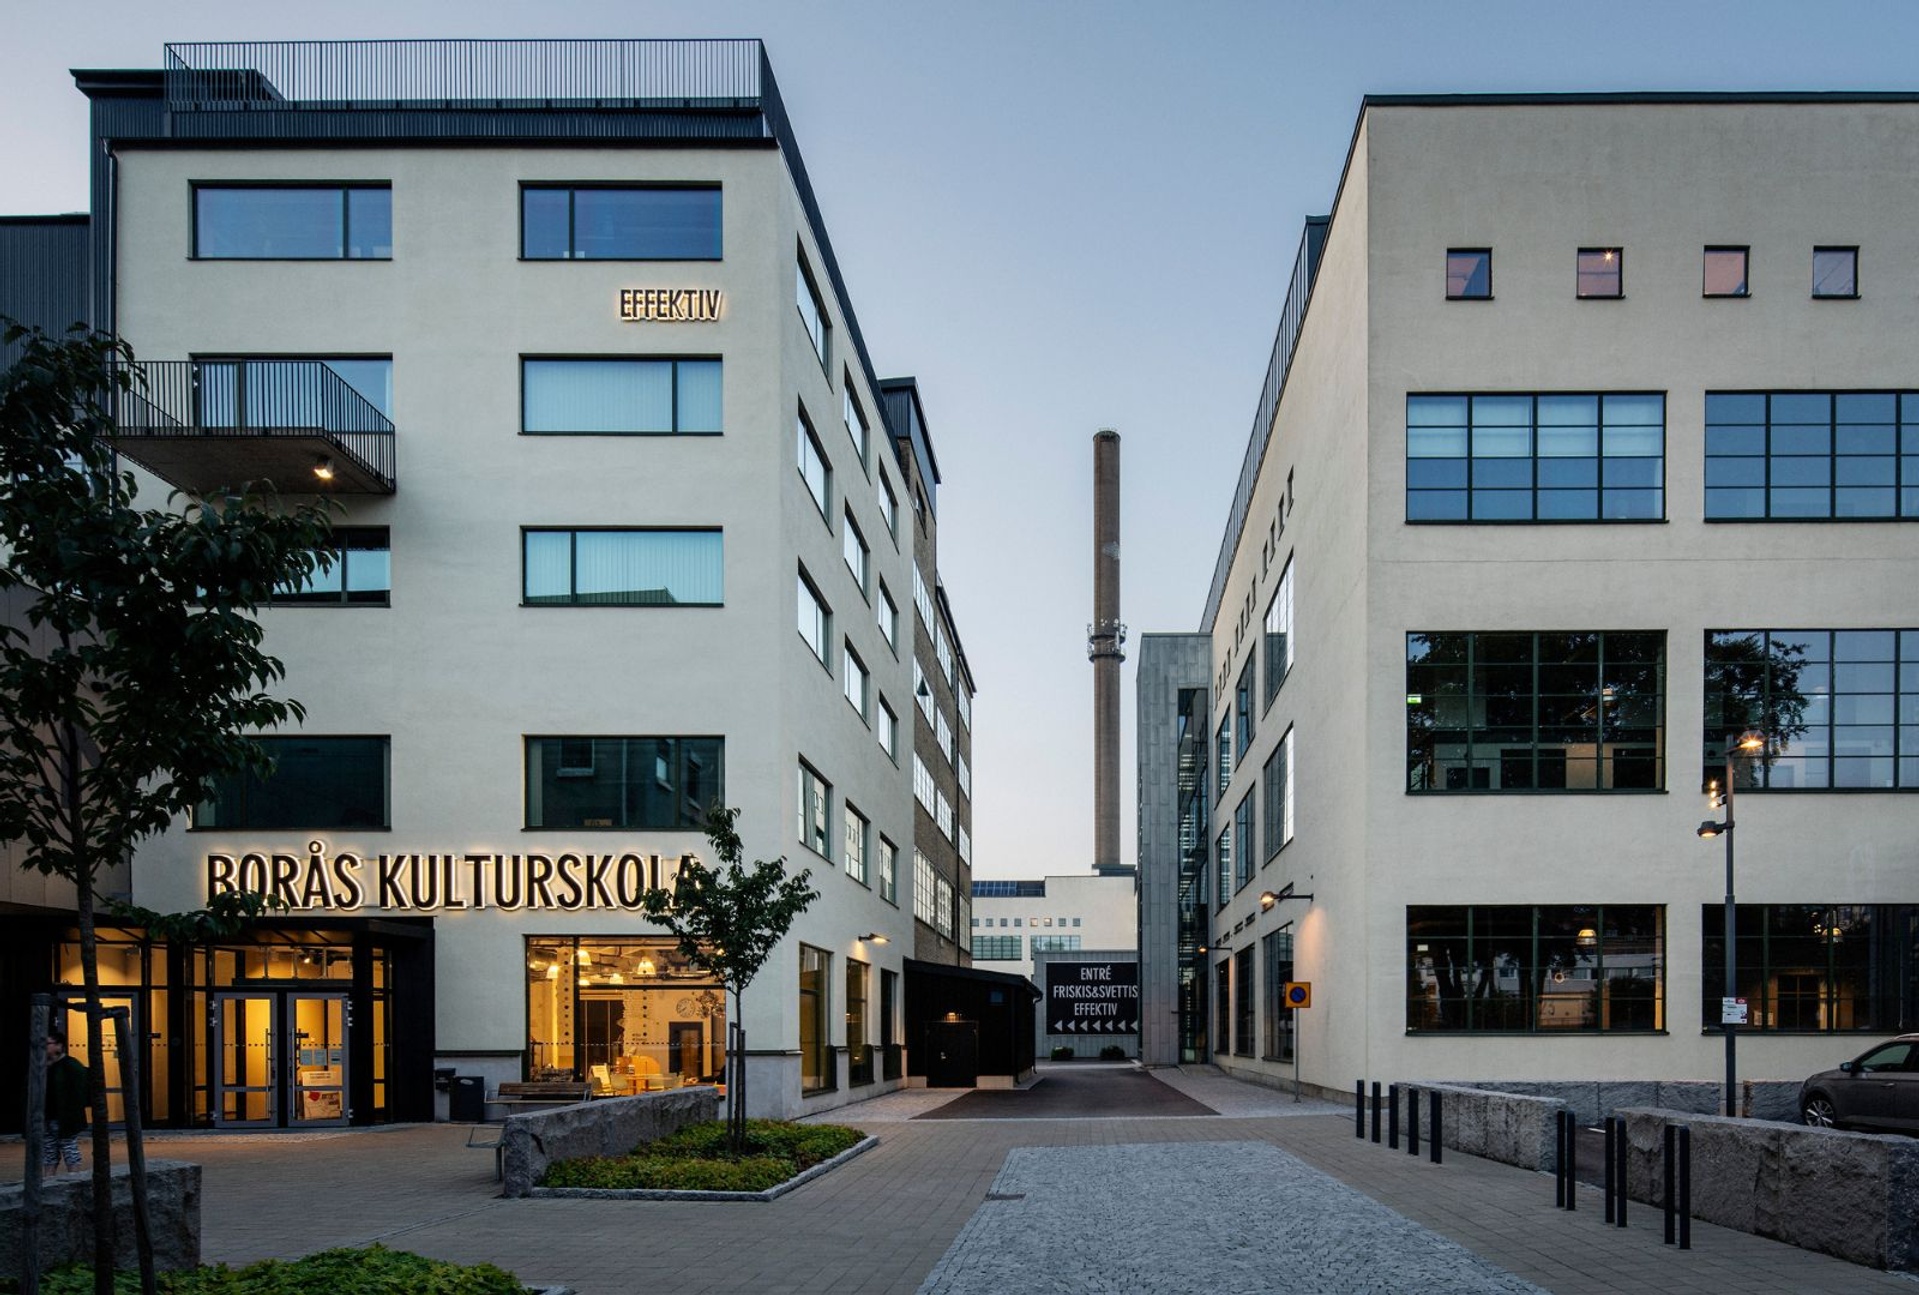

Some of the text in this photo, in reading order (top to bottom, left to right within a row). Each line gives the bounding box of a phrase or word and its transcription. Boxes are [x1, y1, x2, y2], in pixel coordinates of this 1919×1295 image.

[620, 289, 721, 321] EFFEKTIV
[207, 840, 363, 911] BORÅS
[1080, 965, 1112, 980] ENTRÉ
[1053, 984, 1138, 999] FRISKIS&SVETTIS
[1074, 1002, 1118, 1016] EFFEKTIV
